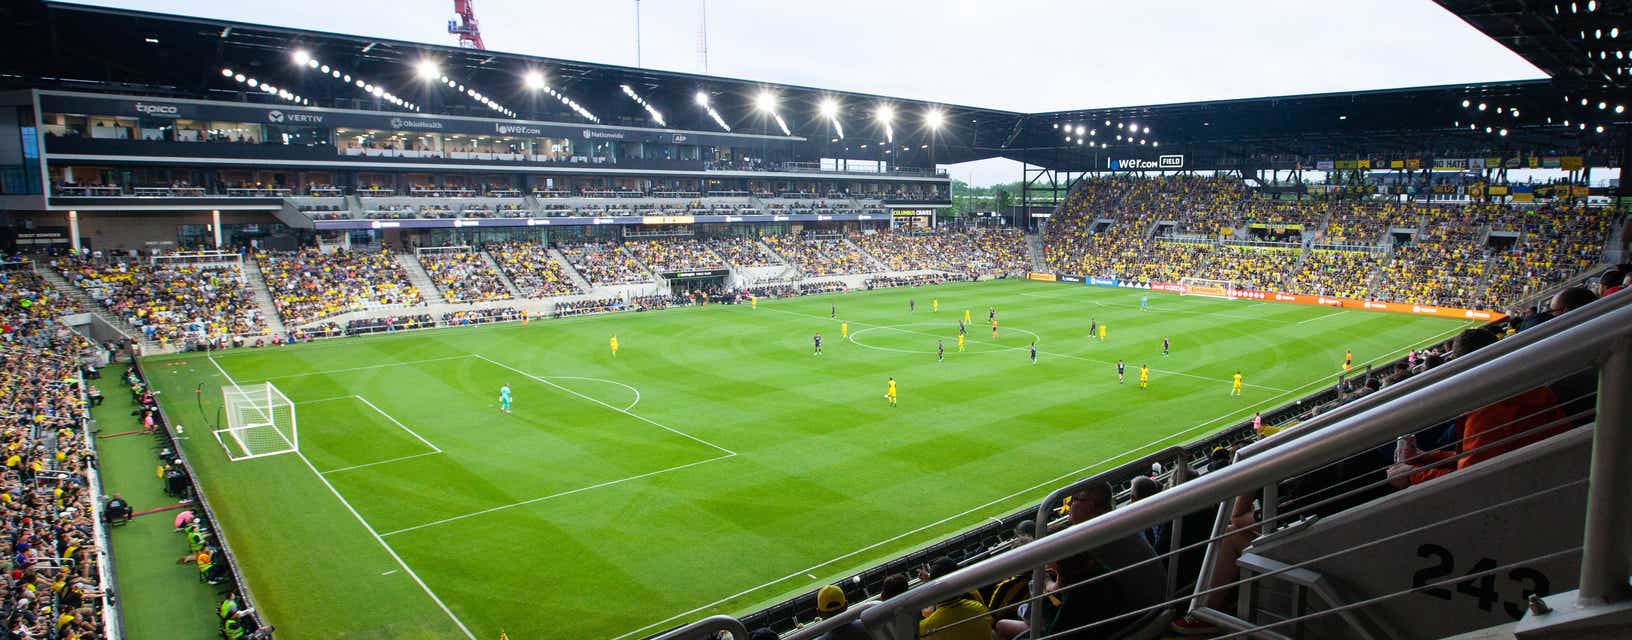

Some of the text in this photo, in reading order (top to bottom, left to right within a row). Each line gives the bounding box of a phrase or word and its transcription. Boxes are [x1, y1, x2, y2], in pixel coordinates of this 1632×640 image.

[135, 102, 178, 114] tipico
[287, 114, 323, 123] VERTIV
[403, 120, 443, 129] OhioHealth
[1412, 543, 1549, 620] 243
